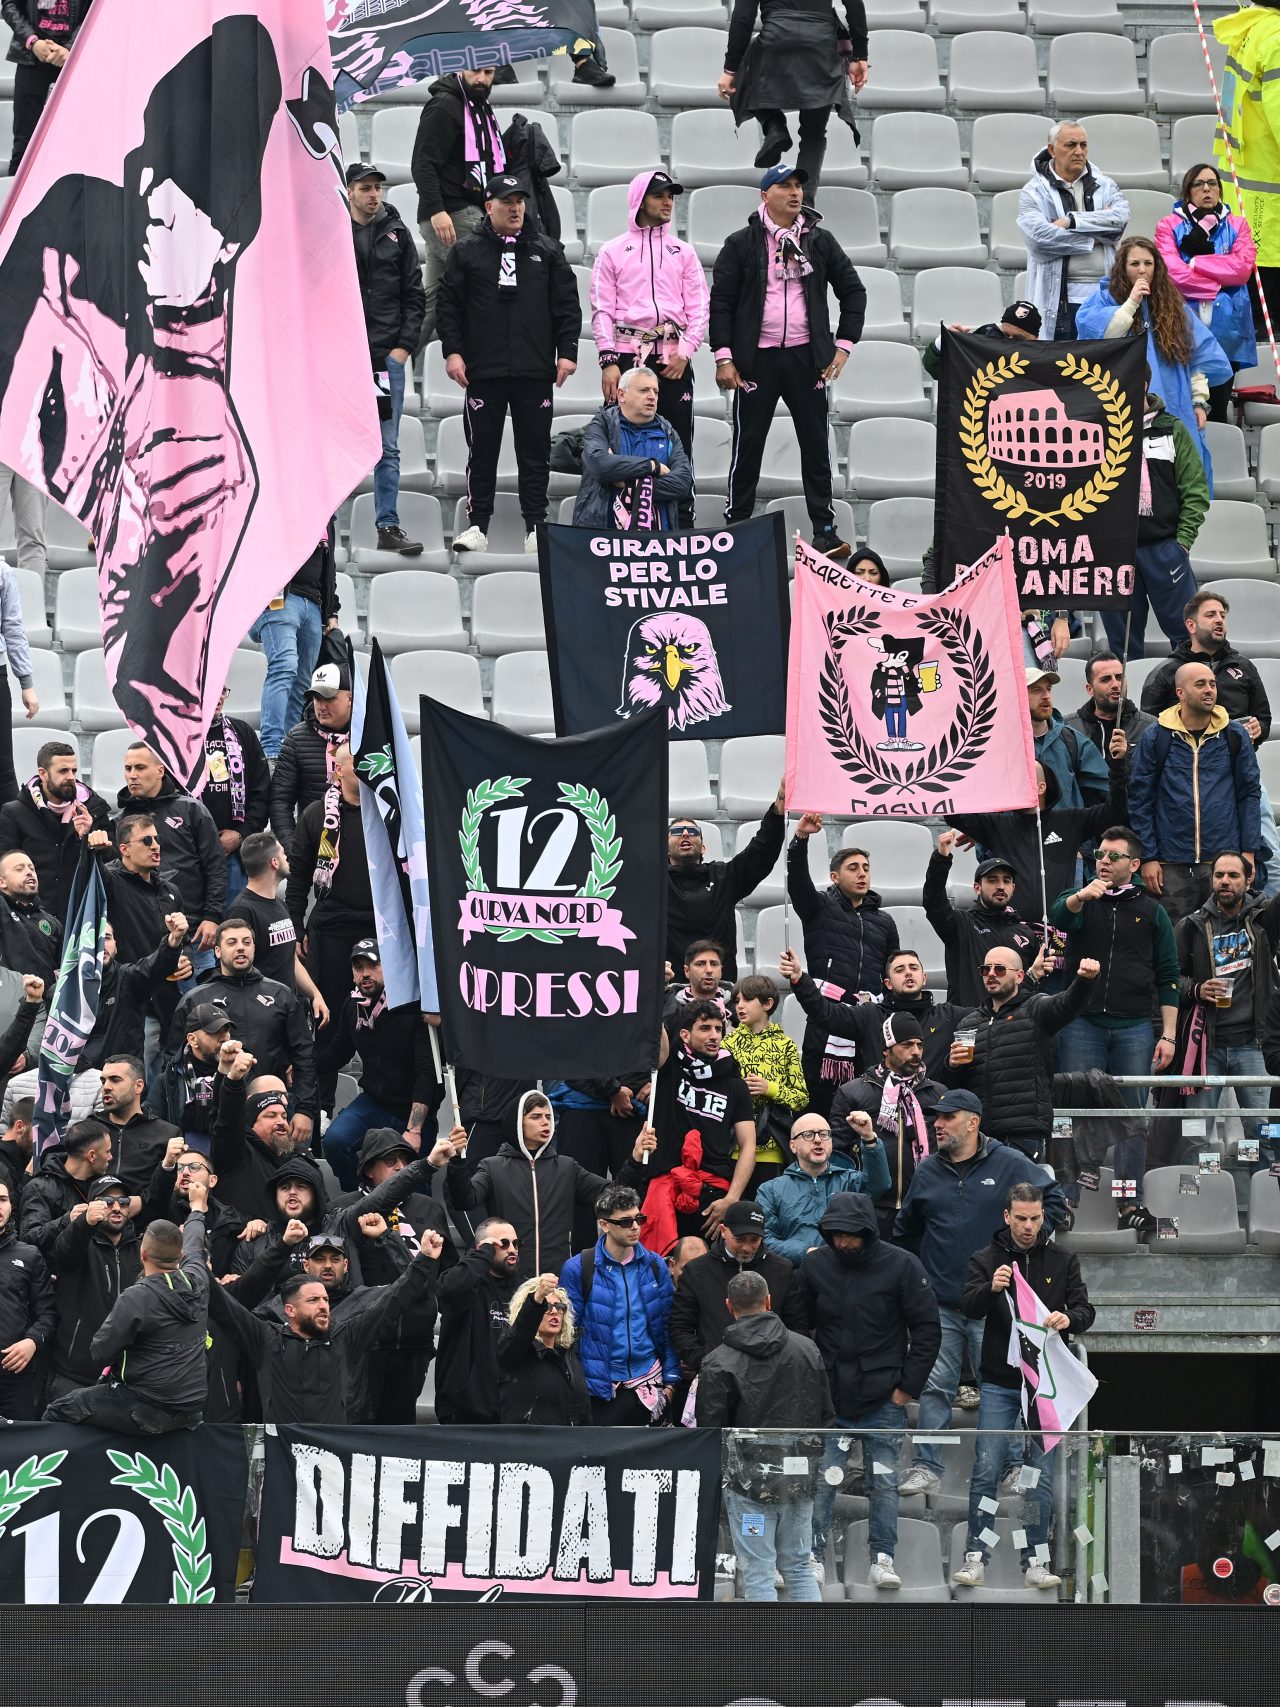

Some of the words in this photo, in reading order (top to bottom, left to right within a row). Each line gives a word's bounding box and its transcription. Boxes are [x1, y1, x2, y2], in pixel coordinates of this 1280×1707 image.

[1024, 471, 1066, 489] 2019
[589, 531, 734, 557] GIRANDO
[609, 561, 672, 583] PER
[679, 558, 718, 582] LO
[955, 563, 1136, 596] ANERO
[605, 583, 728, 608] STIVALE
[902, 599, 917, 608] E
[491, 805, 580, 891] 12
[470, 896, 531, 924] CURVA
[535, 900, 602, 926] NORD
[459, 961, 640, 1018] CIPRESSI
[678, 1079, 696, 1108] LA
[701, 1094, 728, 1119] 12
[291, 1442, 701, 1586] DIFFIDATI
[10, 1508, 147, 1604] 12
